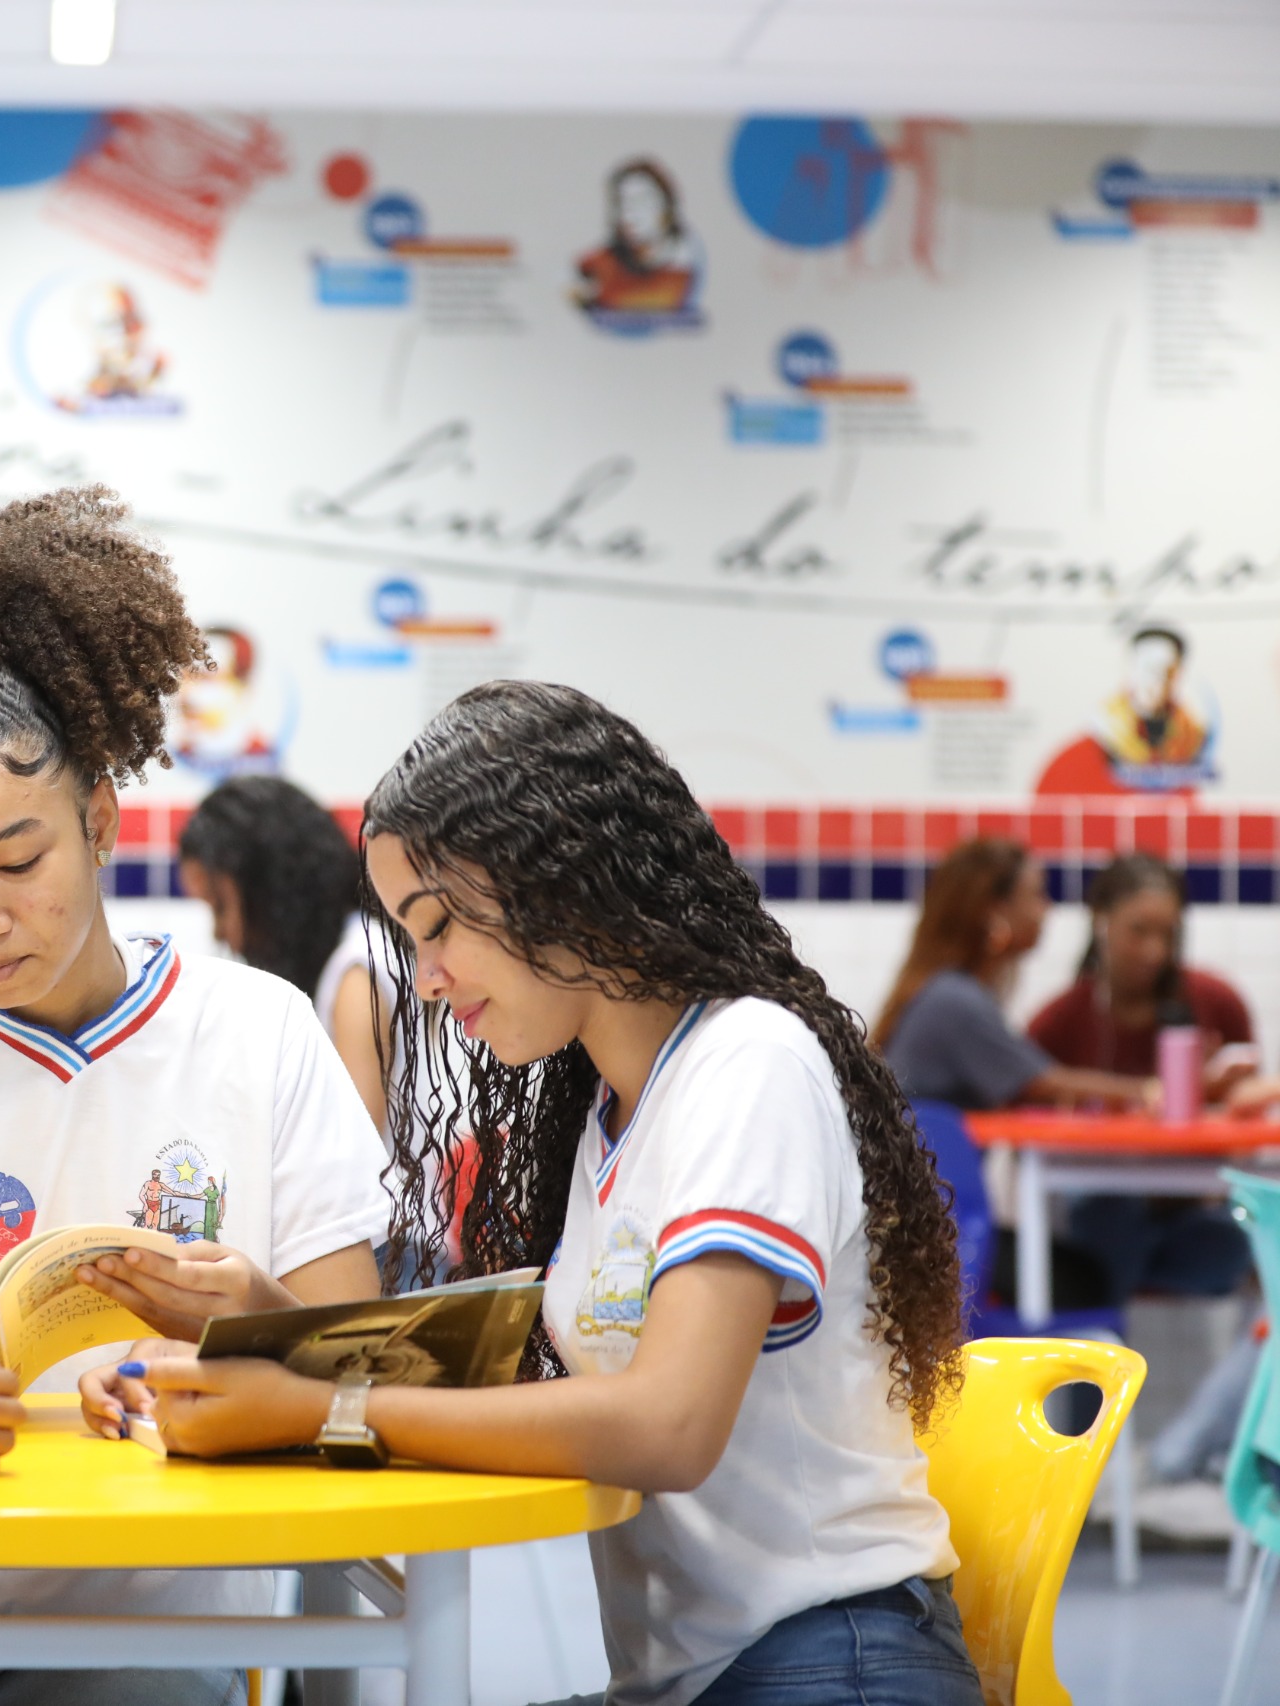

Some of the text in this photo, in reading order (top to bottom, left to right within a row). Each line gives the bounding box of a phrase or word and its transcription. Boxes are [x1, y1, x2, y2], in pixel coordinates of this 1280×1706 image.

[290, 416, 656, 564] Linha
[718, 488, 834, 582] do
[905, 510, 1278, 627] tempo
[155, 1138, 183, 1161] ESTADO
